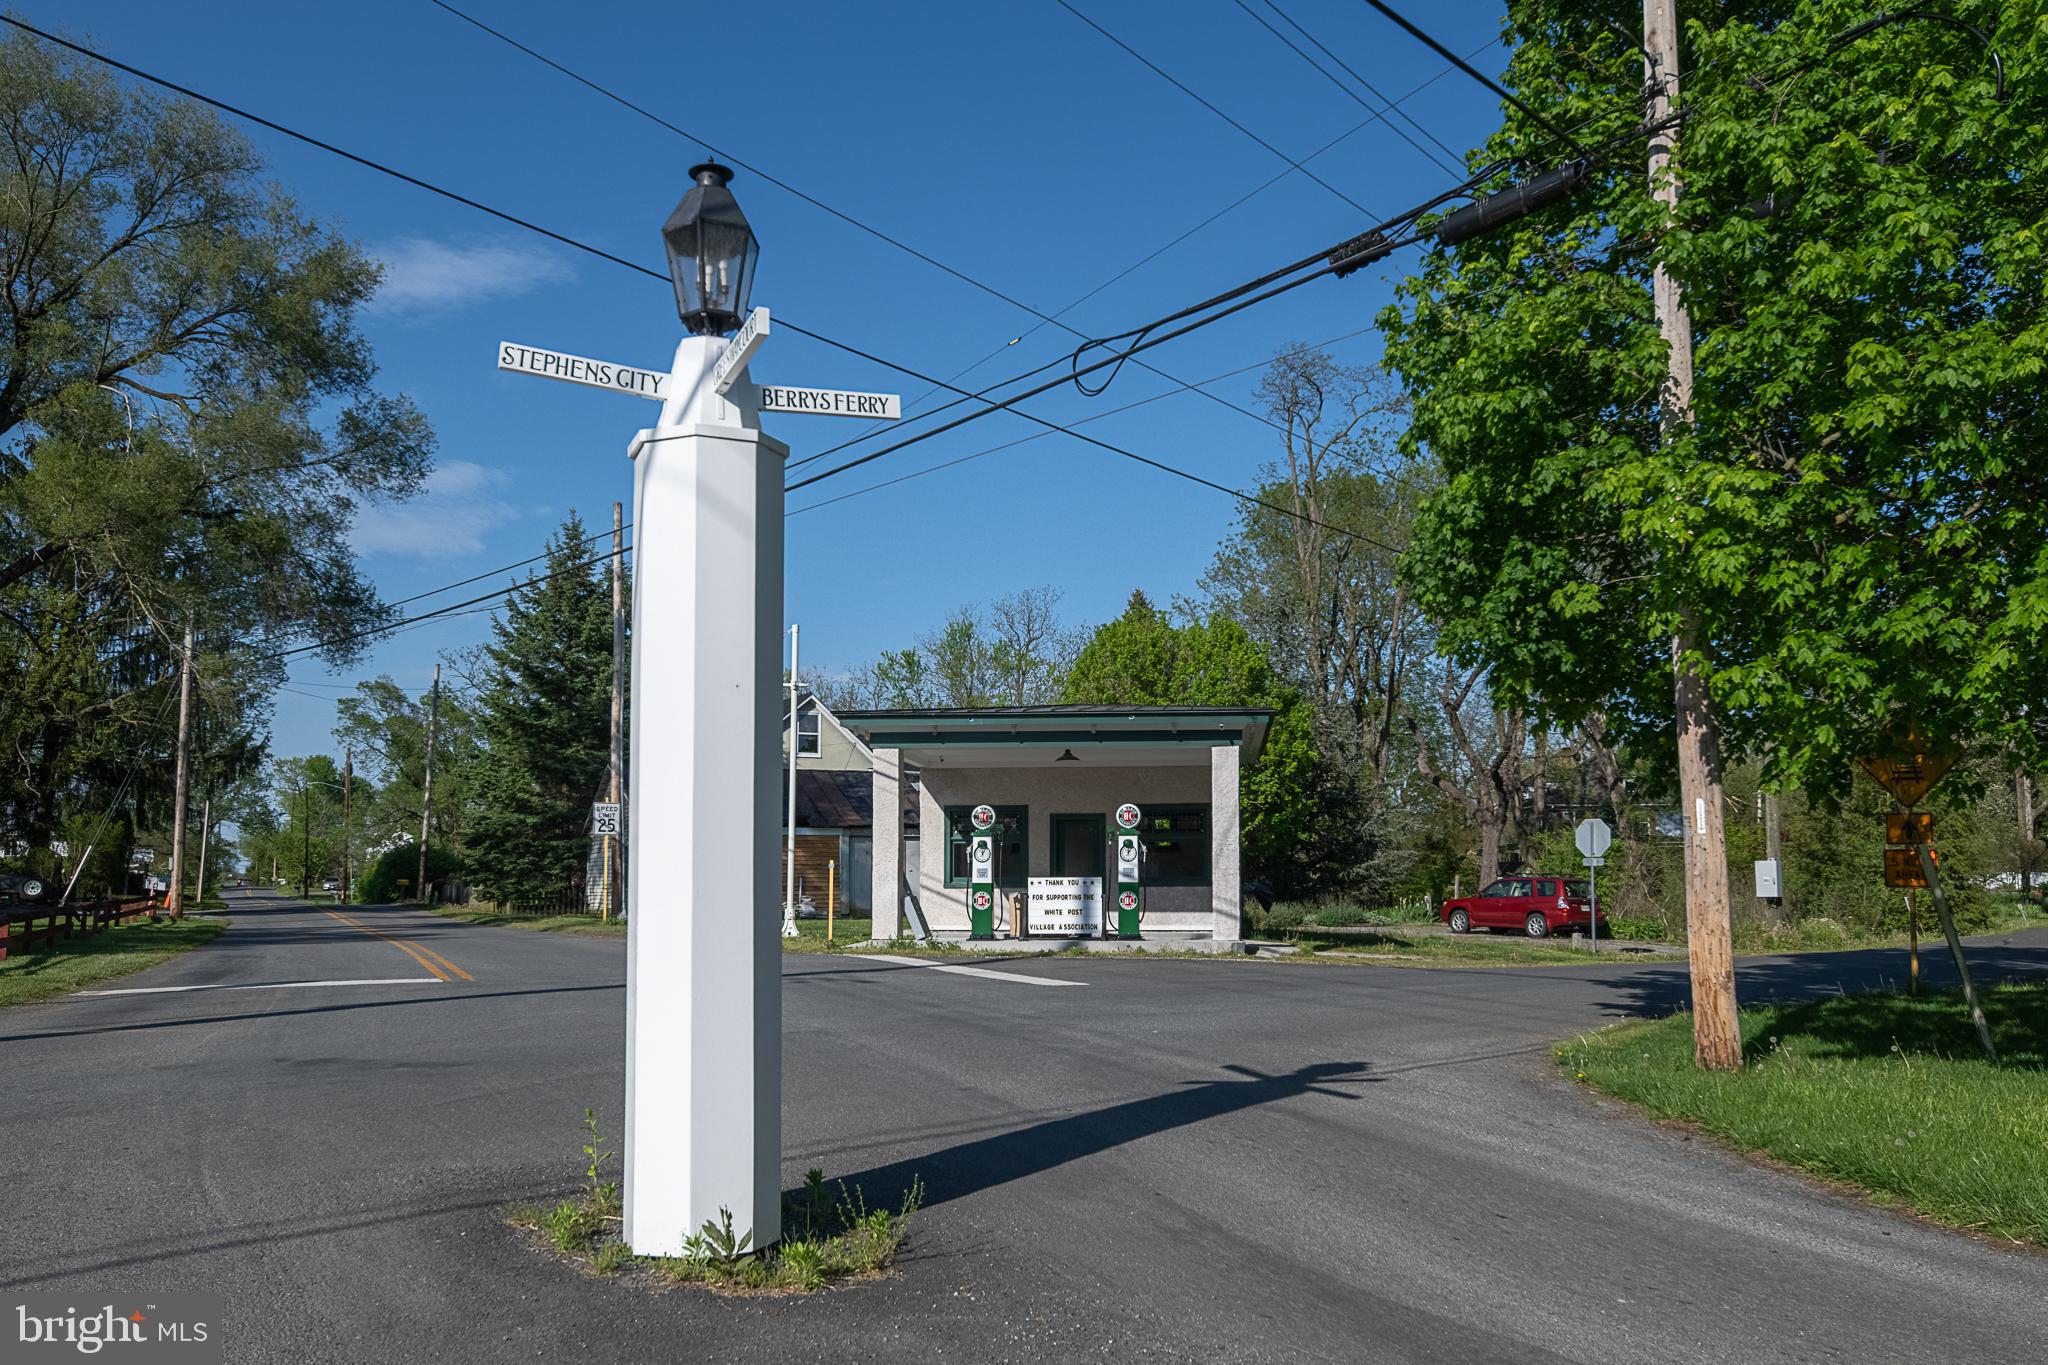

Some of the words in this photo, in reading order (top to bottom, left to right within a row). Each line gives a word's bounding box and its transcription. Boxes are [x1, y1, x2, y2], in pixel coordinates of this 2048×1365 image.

[502, 346, 611, 384] STEPHENS
[616, 369, 663, 393] CITY
[762, 388, 830, 410] BERRYS
[834, 394, 888, 414] FERRY
[598, 818, 615, 832] 25
